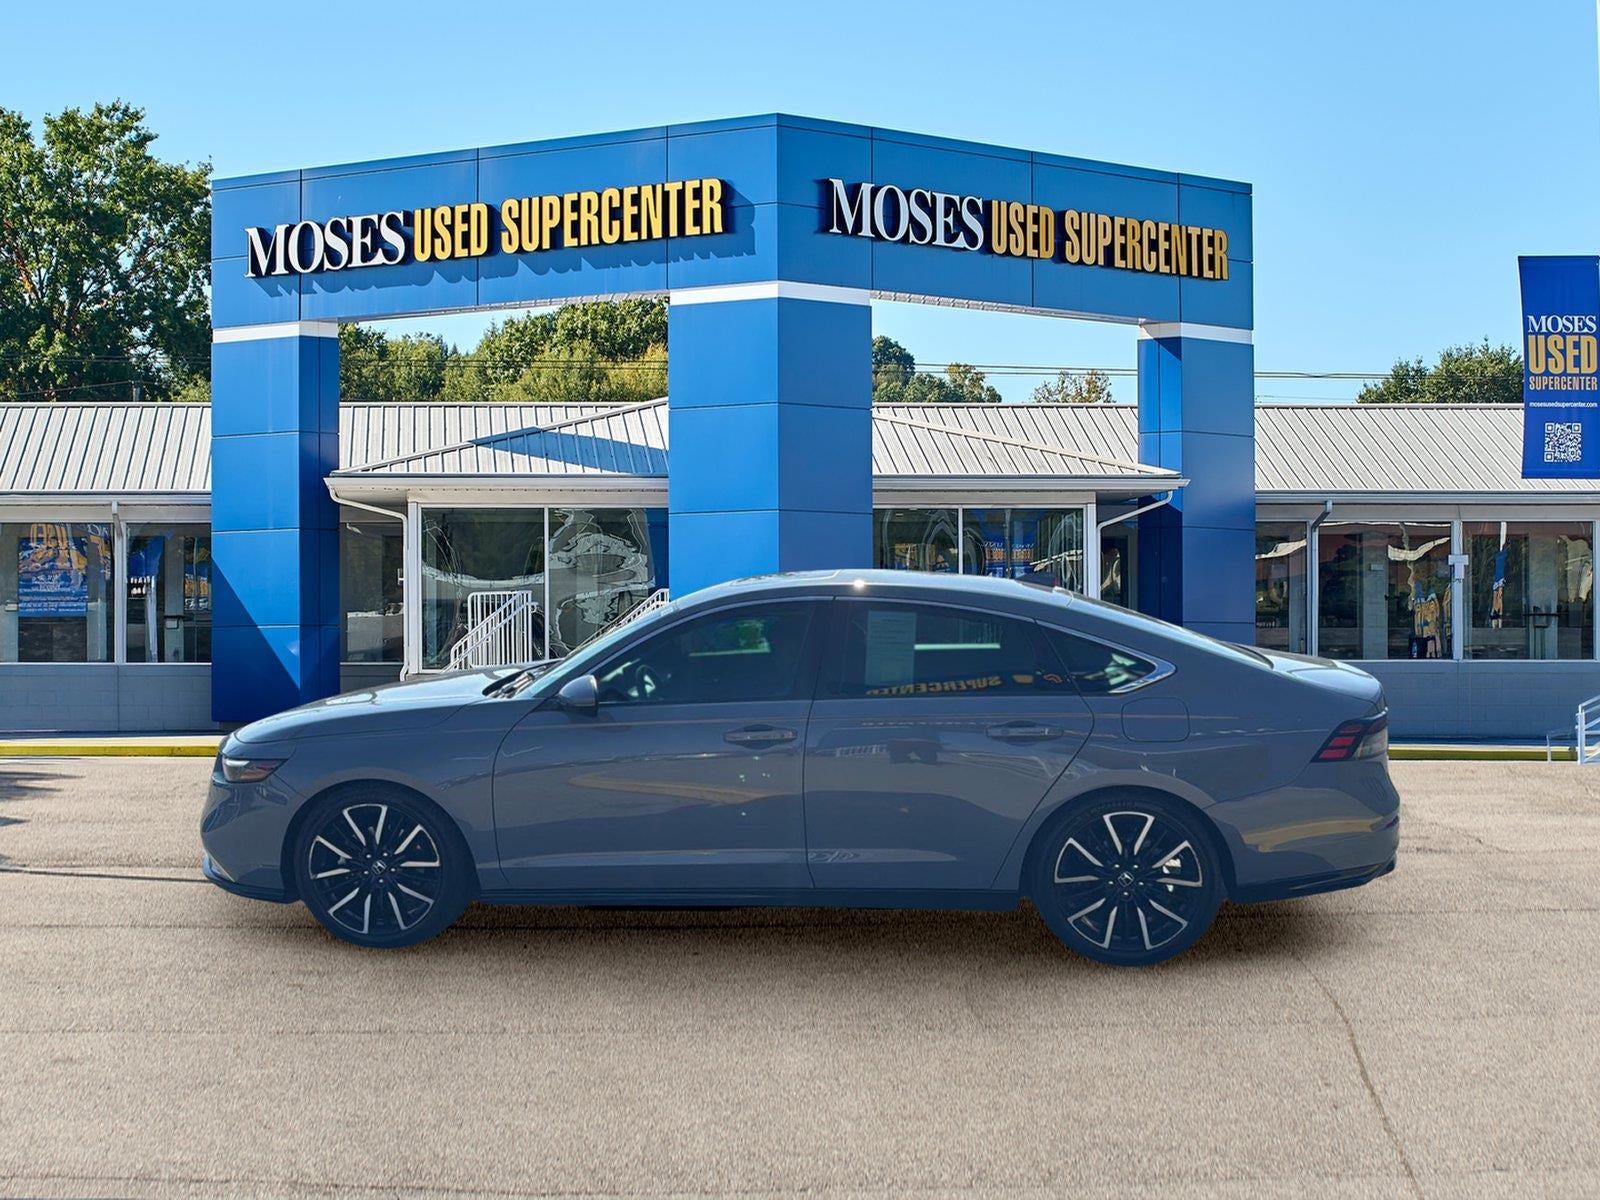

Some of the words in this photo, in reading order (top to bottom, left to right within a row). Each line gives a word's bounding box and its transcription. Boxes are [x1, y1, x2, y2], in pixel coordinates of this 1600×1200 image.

[244, 210, 407, 279] MOSES
[412, 202, 490, 263] USED
[500, 177, 725, 255] SUPERCENTER
[828, 177, 985, 252] MOSES
[990, 199, 1056, 260] USED
[1064, 209, 1230, 281] SUPERCENTER
[1527, 315, 1598, 333] MOSES
[1528, 335, 1598, 374] USED
[1529, 376, 1598, 391] SUPERCENTER
[1529, 401, 1598, 409] mosesusedsupercenter.com
